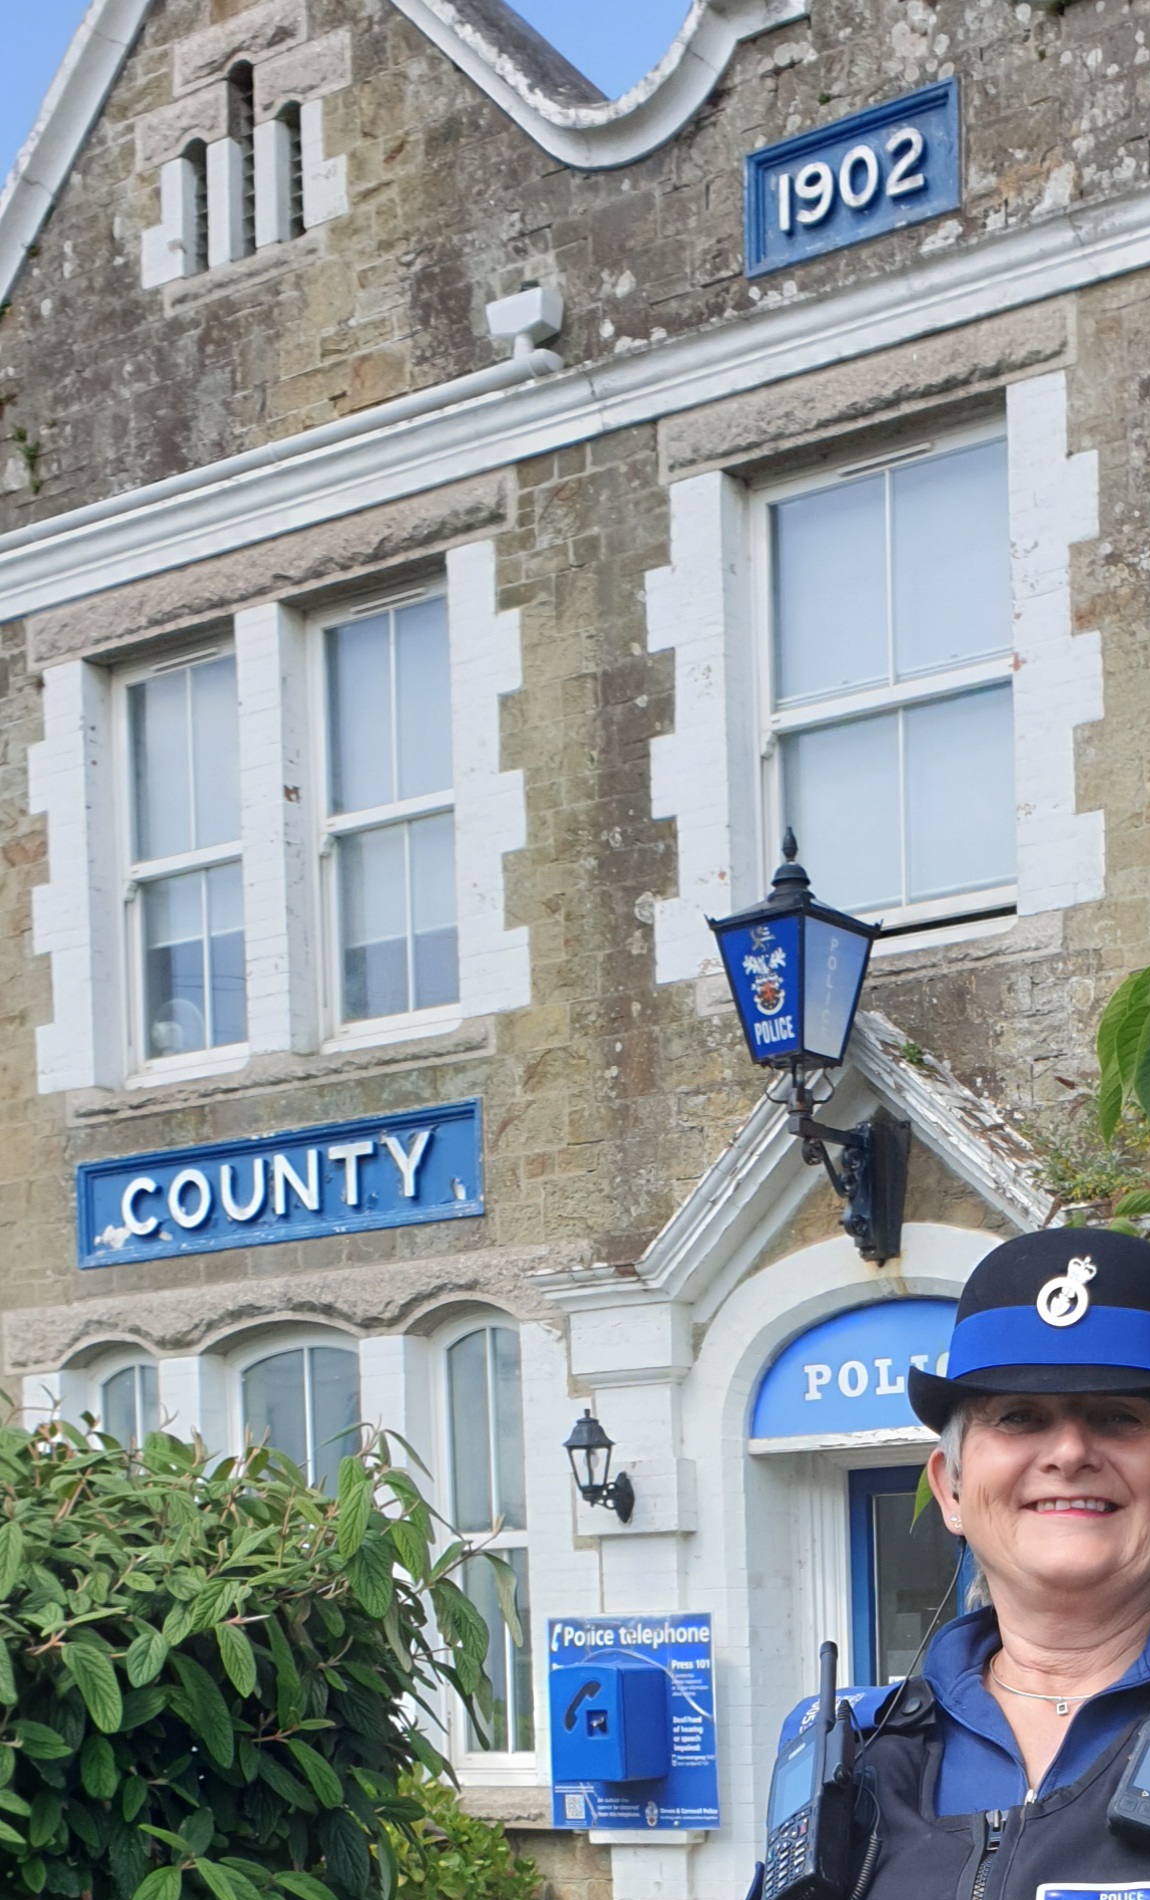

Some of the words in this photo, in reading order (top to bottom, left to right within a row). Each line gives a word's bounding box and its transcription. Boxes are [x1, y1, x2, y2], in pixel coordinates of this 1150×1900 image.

[777, 126, 926, 233] 1902
[754, 1015, 796, 1046] POLICE
[121, 1130, 433, 1236] COUNTY
[803, 1352, 949, 1401] POL
[564, 1624, 615, 1647] Police
[619, 1621, 711, 1650] telephone
[671, 1659, 694, 1670] Press
[695, 1659, 711, 1669] 101
